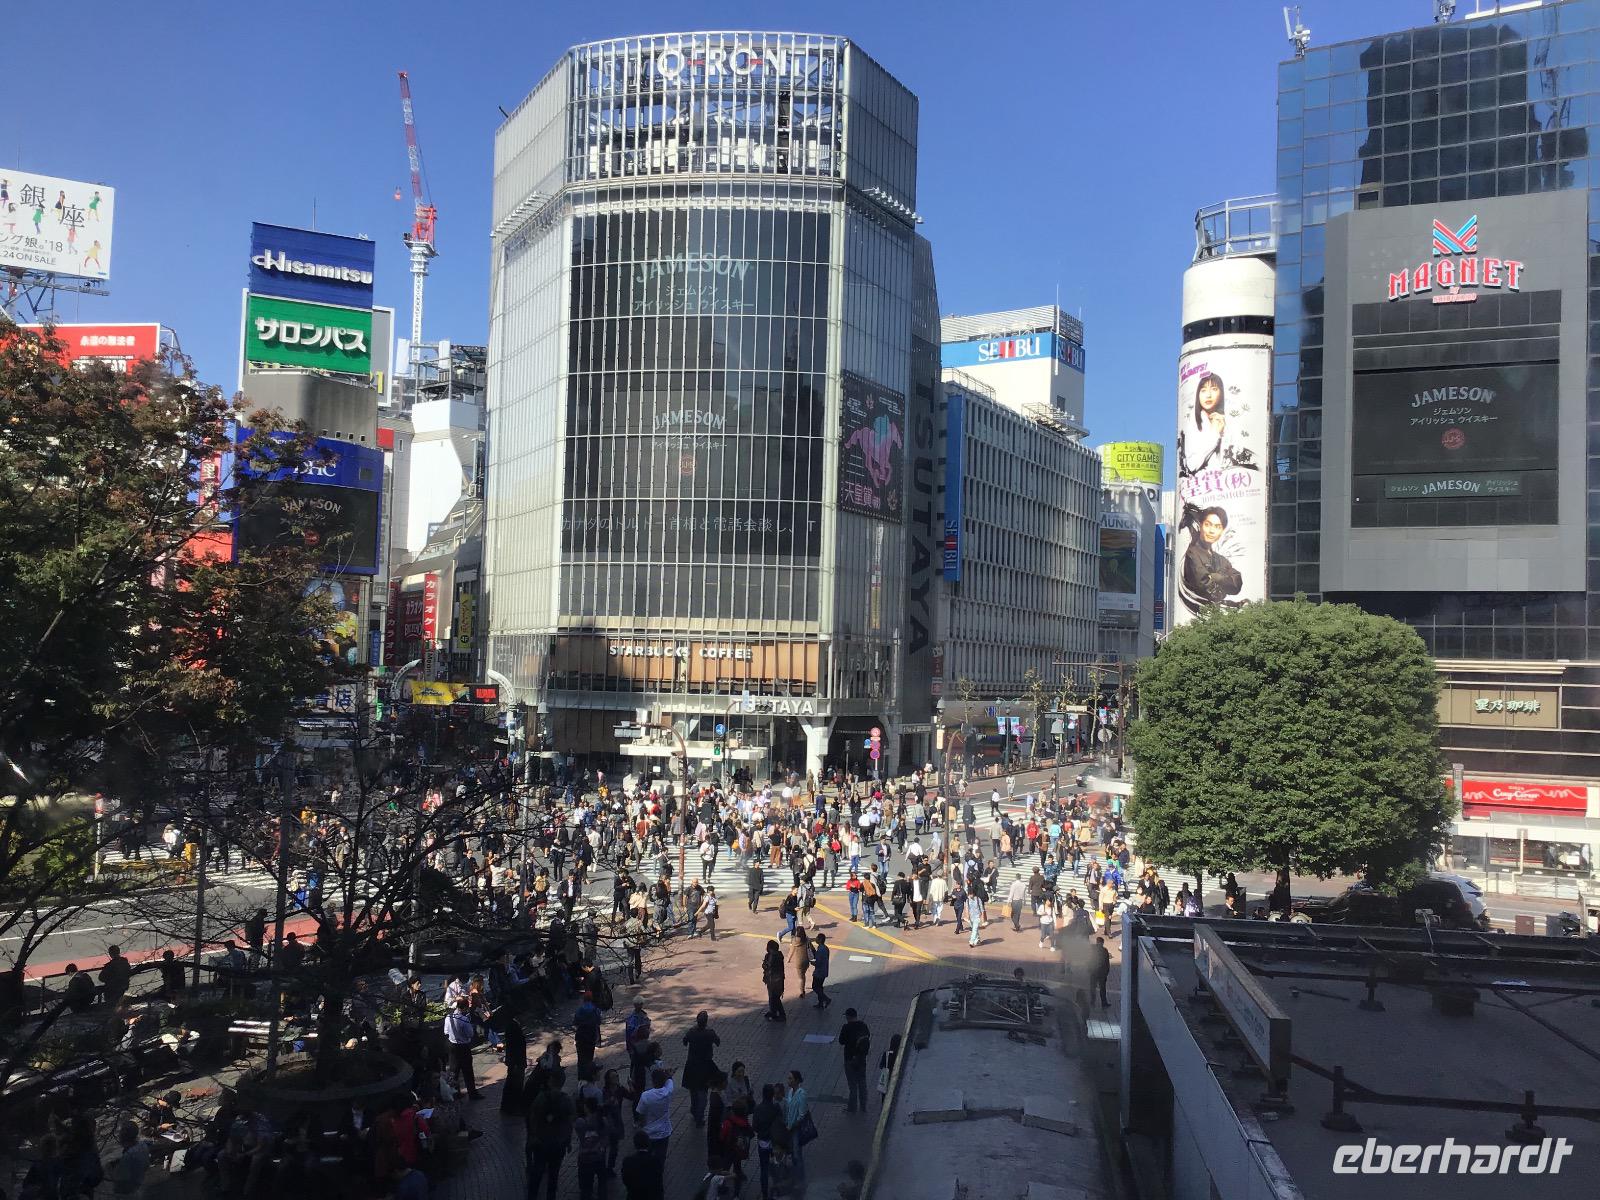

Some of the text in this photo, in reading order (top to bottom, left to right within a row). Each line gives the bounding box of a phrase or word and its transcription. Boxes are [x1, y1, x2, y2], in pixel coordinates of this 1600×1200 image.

[252, 249, 373, 285] Hisamitsu
[636, 252, 751, 283] JAMESON
[1388, 257, 1524, 300] MAGNET
[254, 316, 367, 353] サロンパス
[978, 337, 1040, 362] SEIBU
[1411, 386, 1493, 408] JAMESON
[653, 409, 724, 430] JAMESON
[1422, 479, 1480, 495] JAMESON
[944, 519, 958, 570] SEIBU
[609, 645, 752, 660] STARBUCKS COFFEE
